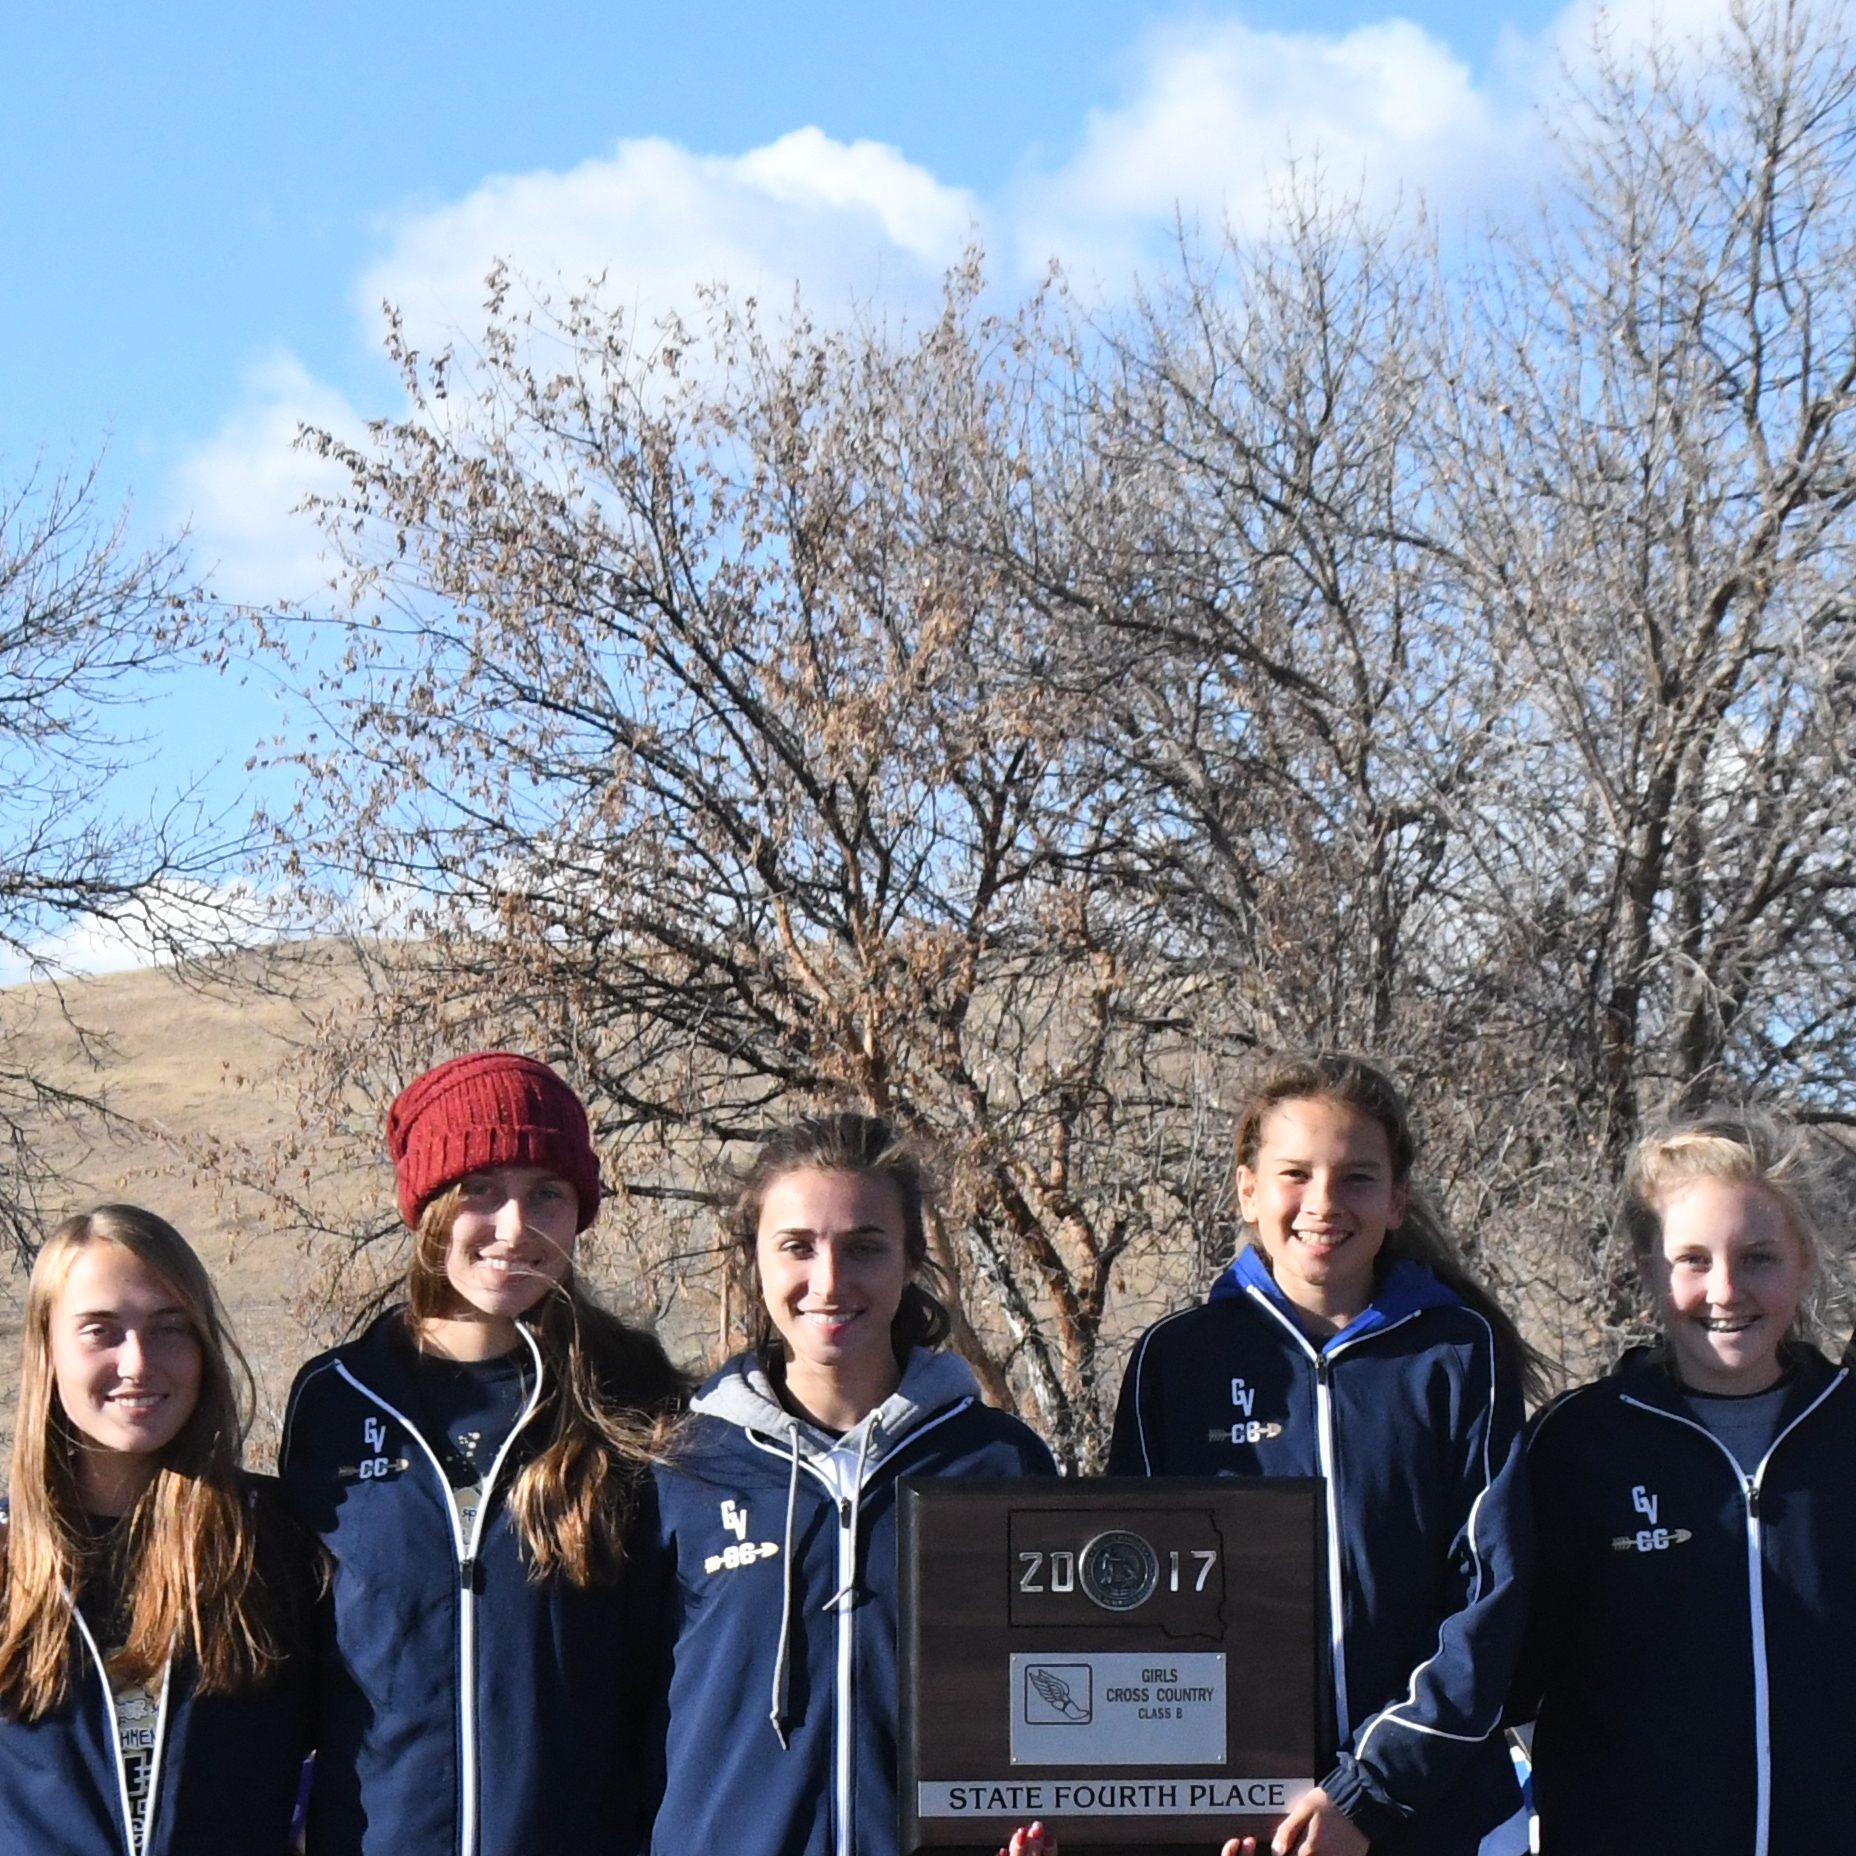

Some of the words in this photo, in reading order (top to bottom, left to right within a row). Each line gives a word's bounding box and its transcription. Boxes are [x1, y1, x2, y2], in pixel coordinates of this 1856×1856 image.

[1231, 1378, 1255, 1417] GV
[364, 1417, 386, 1453] GV
[1231, 1421, 1261, 1444] CC
[359, 1457, 388, 1479] CC
[1632, 1486, 1658, 1525] GV
[720, 1500, 748, 1540] GV
[1636, 1528, 1669, 1552] CC
[724, 1542, 756, 1570] CC
[1141, 1668, 1178, 1683] GIRLS
[1106, 1688, 1150, 1702] CROSS
[1156, 1687, 1214, 1702] COUNTRY
[1138, 1707, 1171, 1719] CLASS
[1176, 1707, 1183, 1719] B
[949, 1786, 1043, 1810] STATE
[1053, 1784, 1177, 1809] FOURTH
[1189, 1784, 1285, 1806] PLACE
